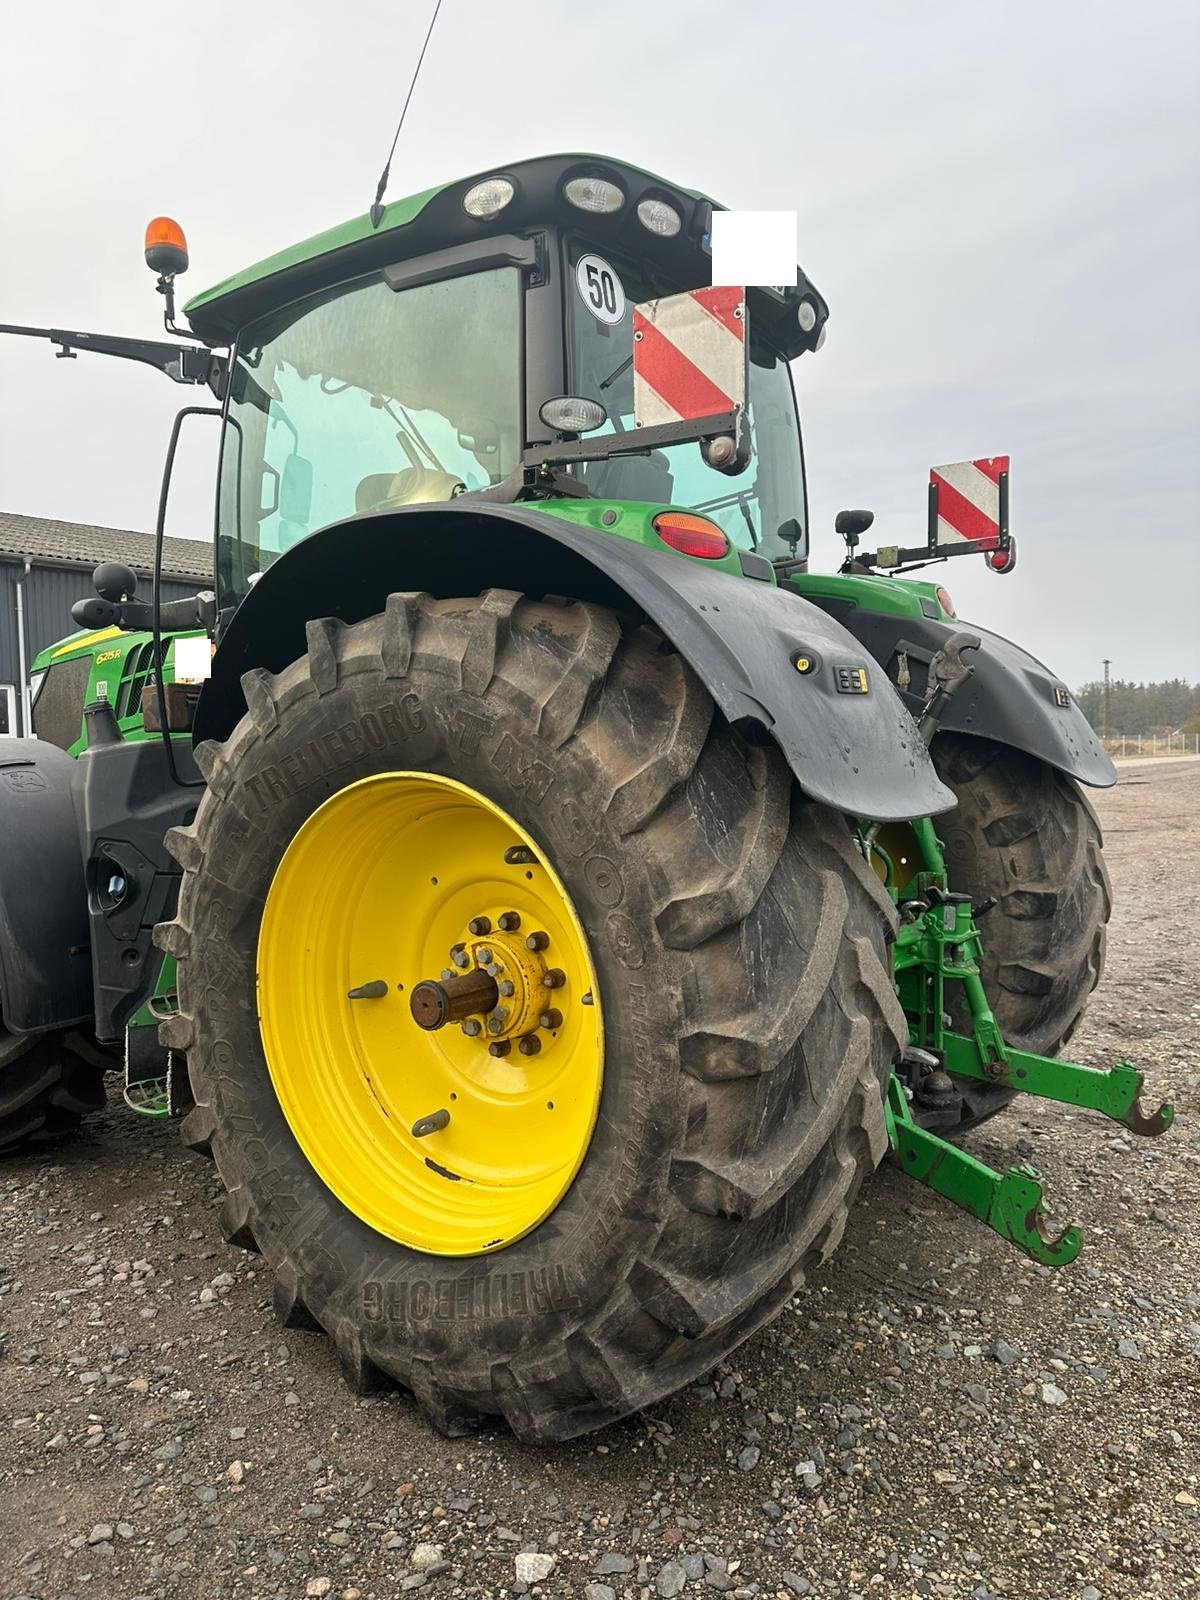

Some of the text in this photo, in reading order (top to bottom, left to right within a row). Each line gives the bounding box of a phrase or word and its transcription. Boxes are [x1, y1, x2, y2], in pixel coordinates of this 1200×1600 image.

[586, 265, 617, 315] 50
[96, 649, 121, 665] 6215R
[244, 692, 427, 811] TRELLEBORG
[363, 1263, 582, 1324] TRELLEBORG
